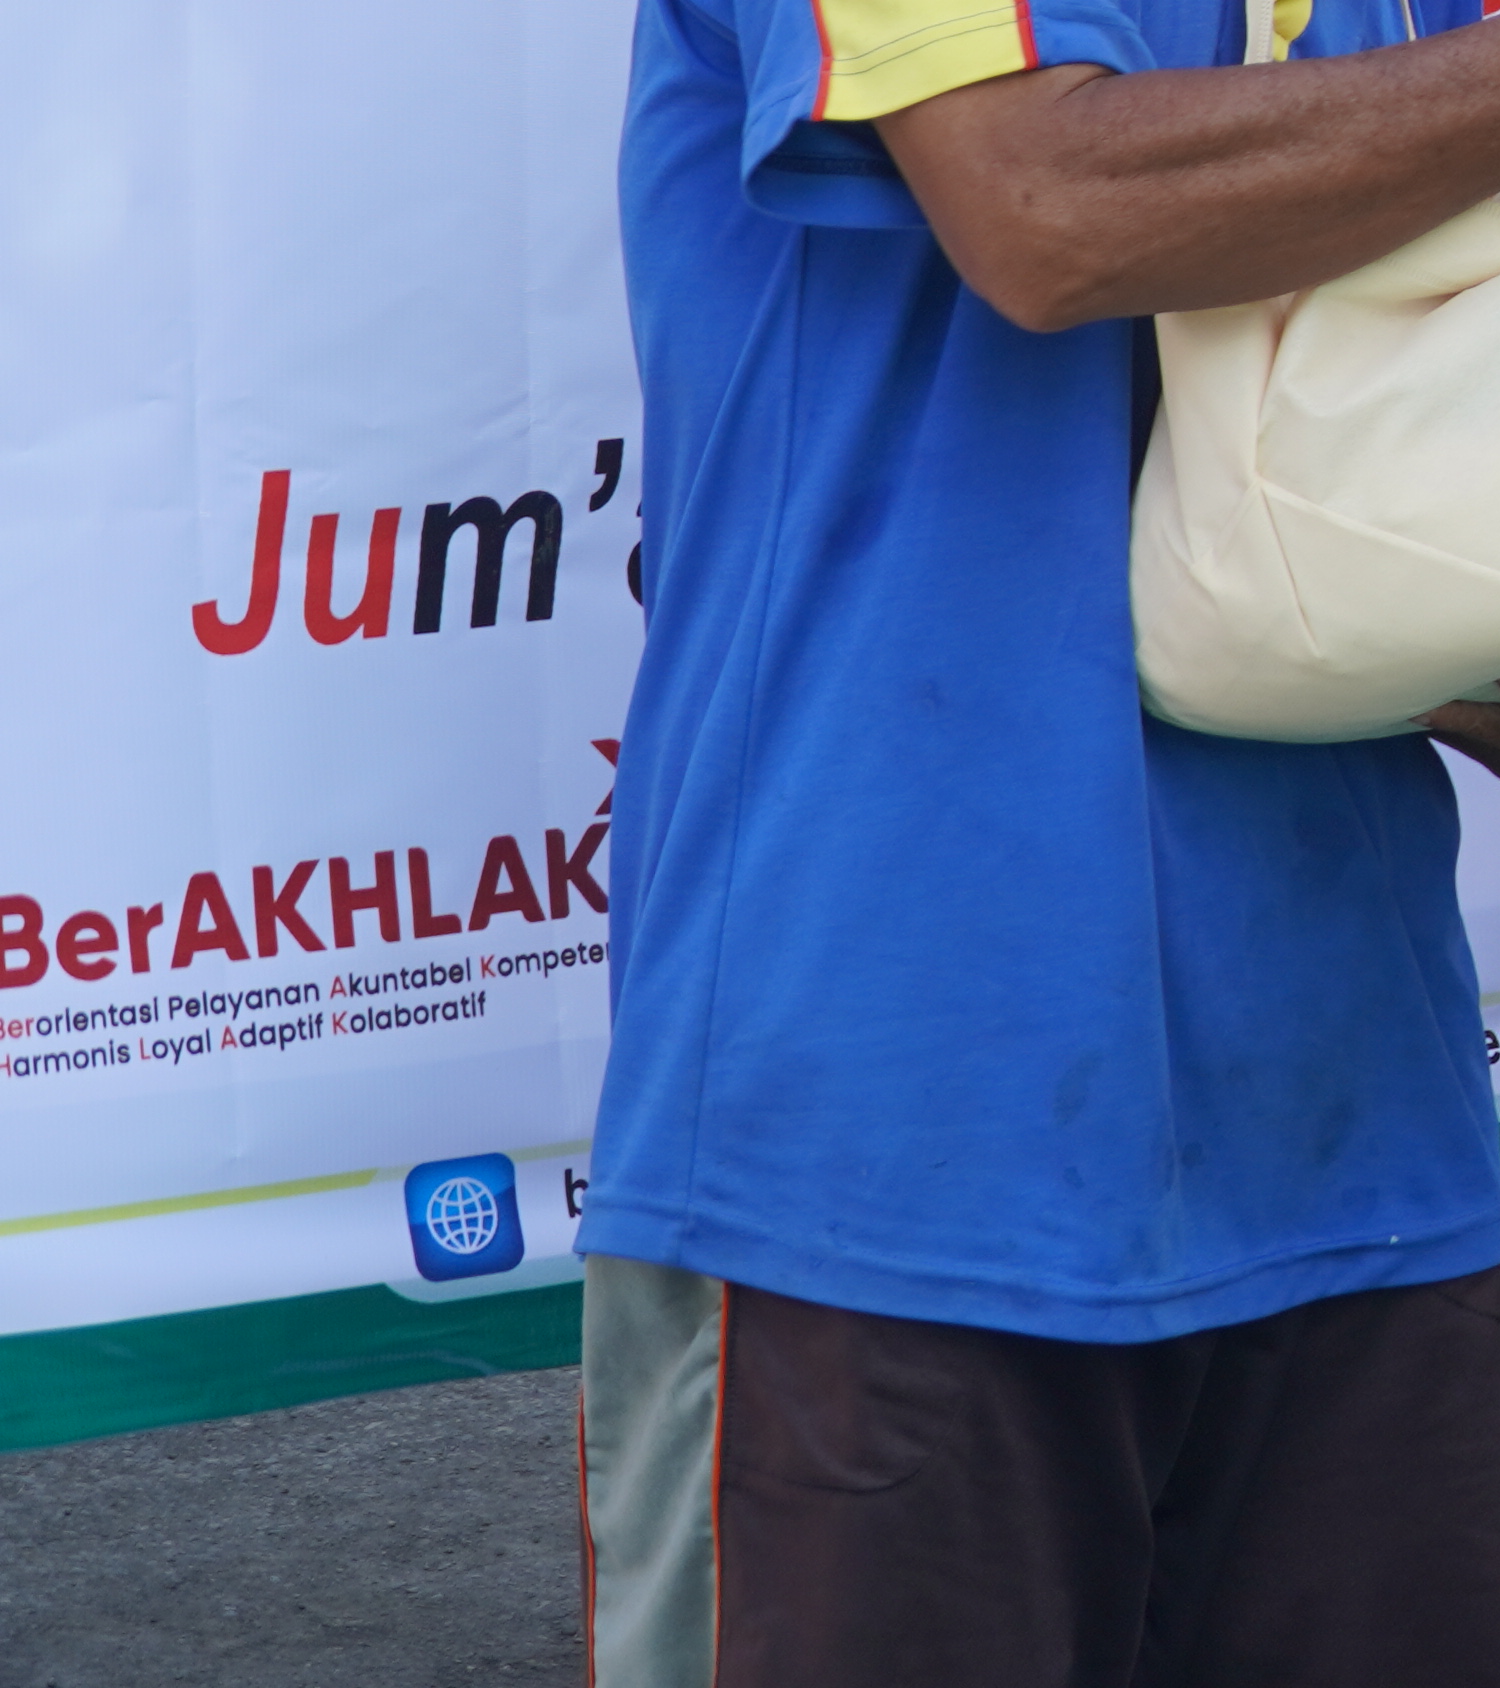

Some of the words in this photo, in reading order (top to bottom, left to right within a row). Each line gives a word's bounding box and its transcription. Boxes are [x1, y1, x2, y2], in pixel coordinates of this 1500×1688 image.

[168, 982, 320, 1024] Pelayanan
[329, 956, 473, 1000] Akuntabel
[480, 940, 609, 980] Kompete
[138, 1028, 212, 1066] Loyal
[220, 1012, 326, 1054] Adaptif
[332, 991, 488, 1037] Kolaboratif
